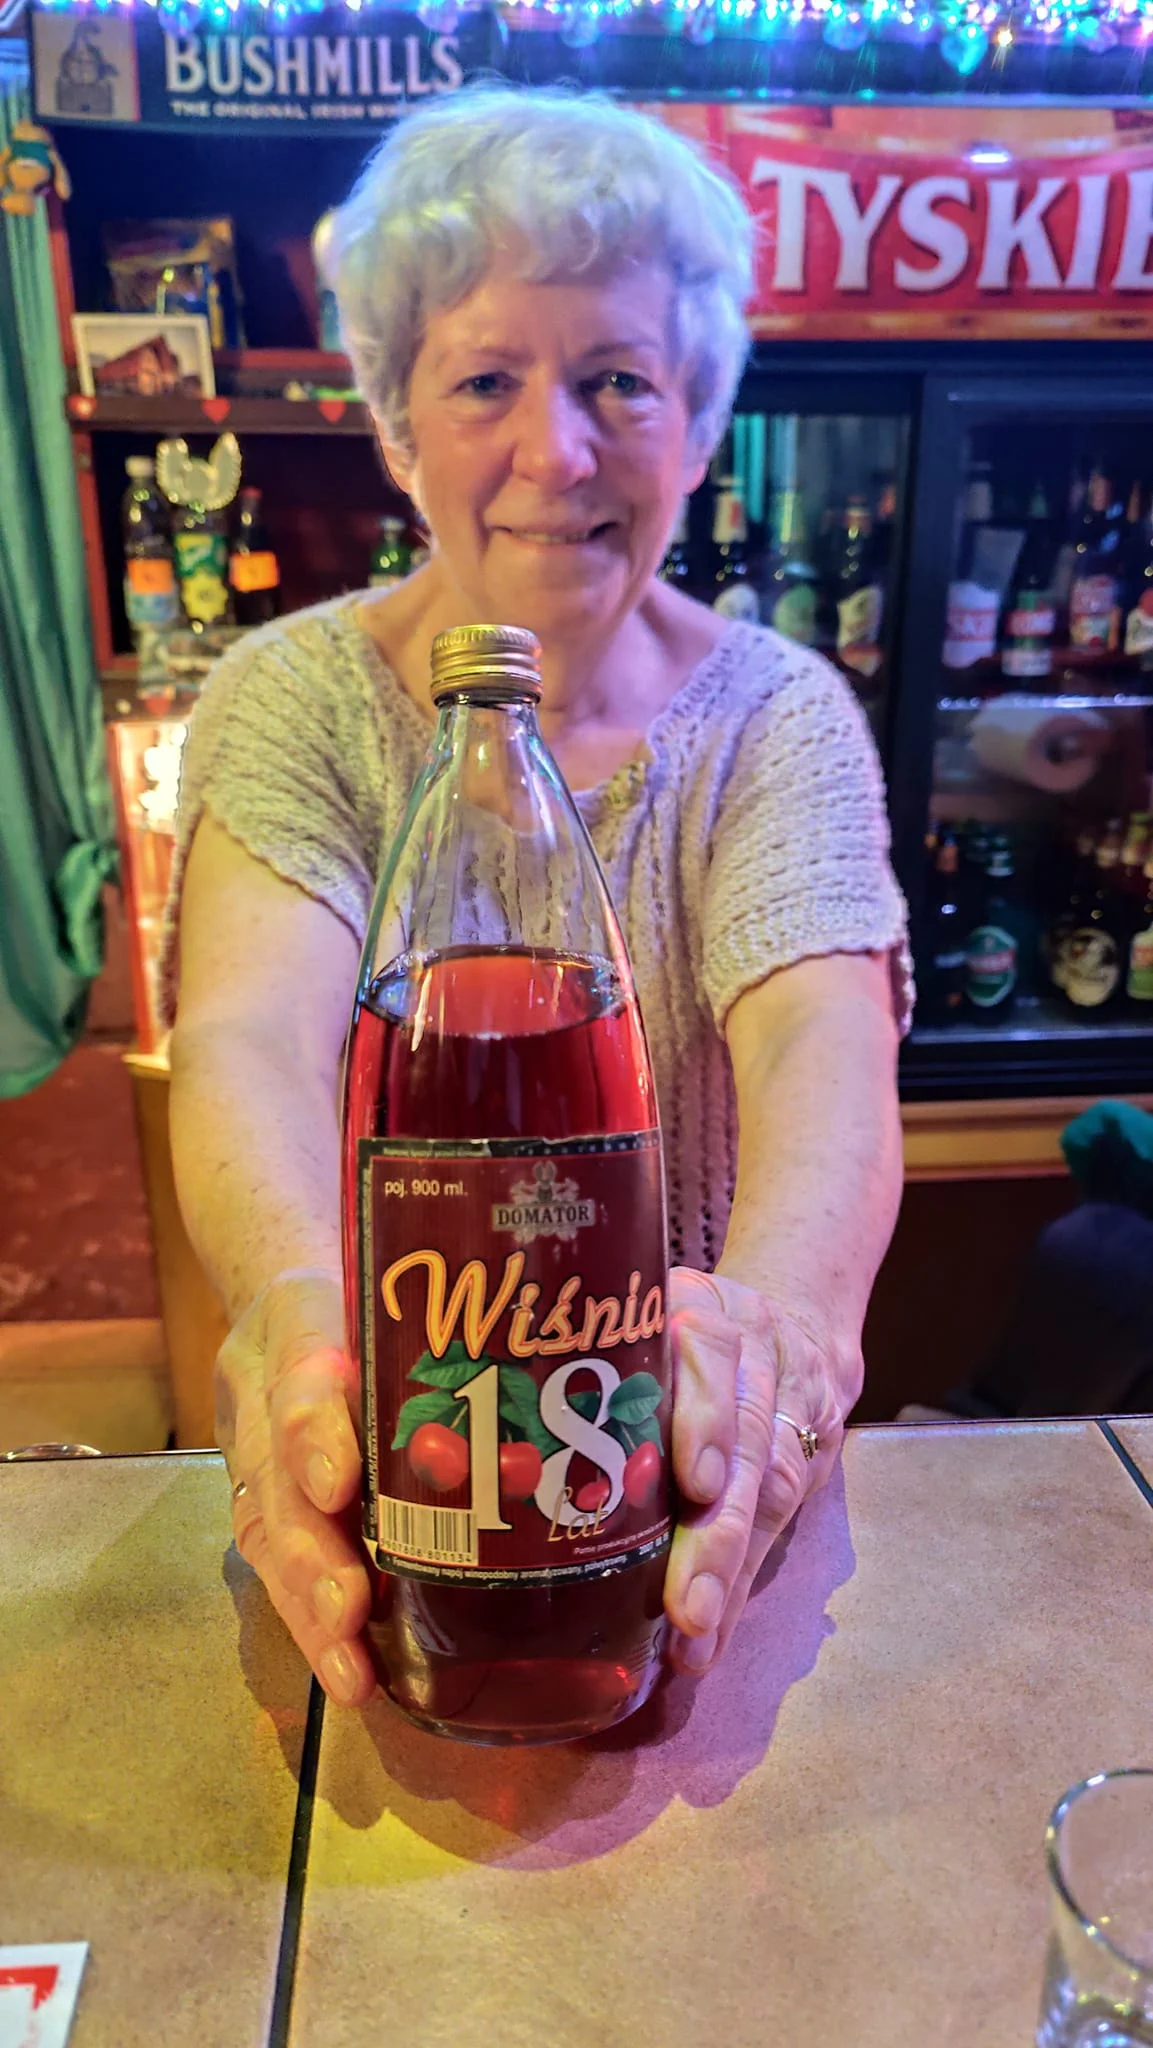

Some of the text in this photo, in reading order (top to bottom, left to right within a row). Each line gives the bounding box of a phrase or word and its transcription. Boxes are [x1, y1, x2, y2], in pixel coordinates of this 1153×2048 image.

[165, 34, 464, 96] BUSHMILLS
[170, 100, 210, 117] THE
[213, 101, 306, 120] ORIGINAL
[384, 1178, 408, 1198] poj.
[411, 1179, 440, 1196] 900
[497, 1206, 590, 1226] DOMATOR
[381, 1250, 665, 1359] Wiśnia
[453, 1358, 627, 1530] 18
[547, 1486, 610, 1542] Lat
